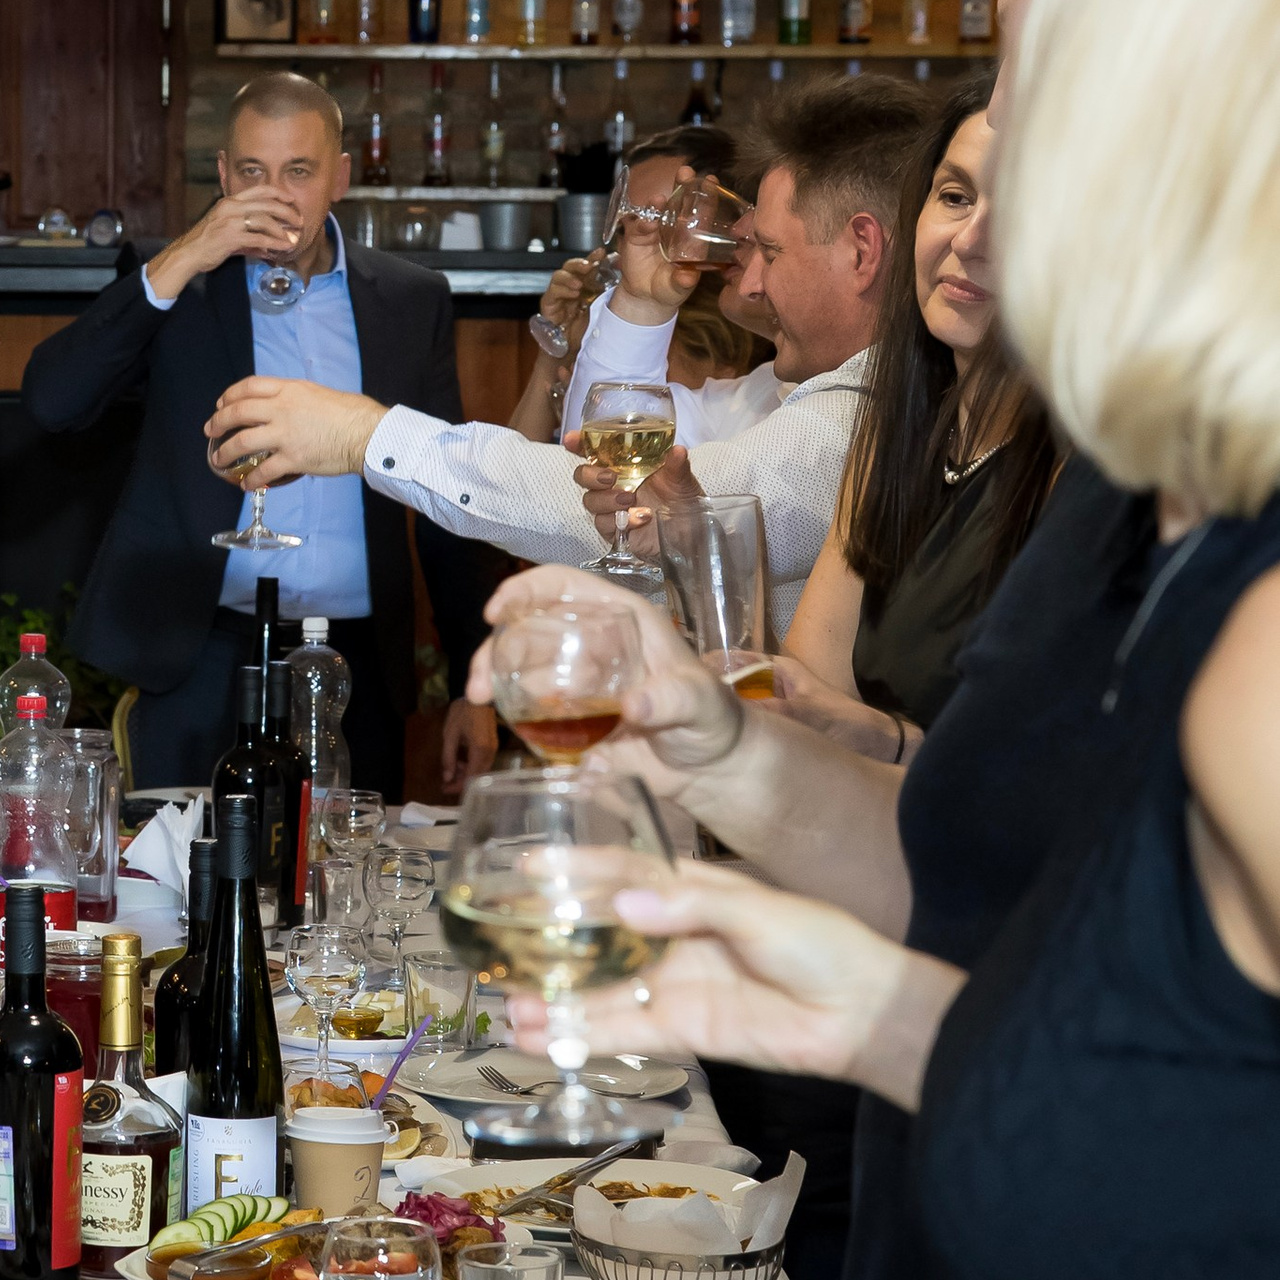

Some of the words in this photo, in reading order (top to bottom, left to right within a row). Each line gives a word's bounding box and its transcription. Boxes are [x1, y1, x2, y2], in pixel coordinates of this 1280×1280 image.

[214, 1153, 244, 1200] F
[353, 1165, 373, 1204] 2
[80, 1184, 128, 1202] nessy
[81, 1207, 106, 1215] GNAC
